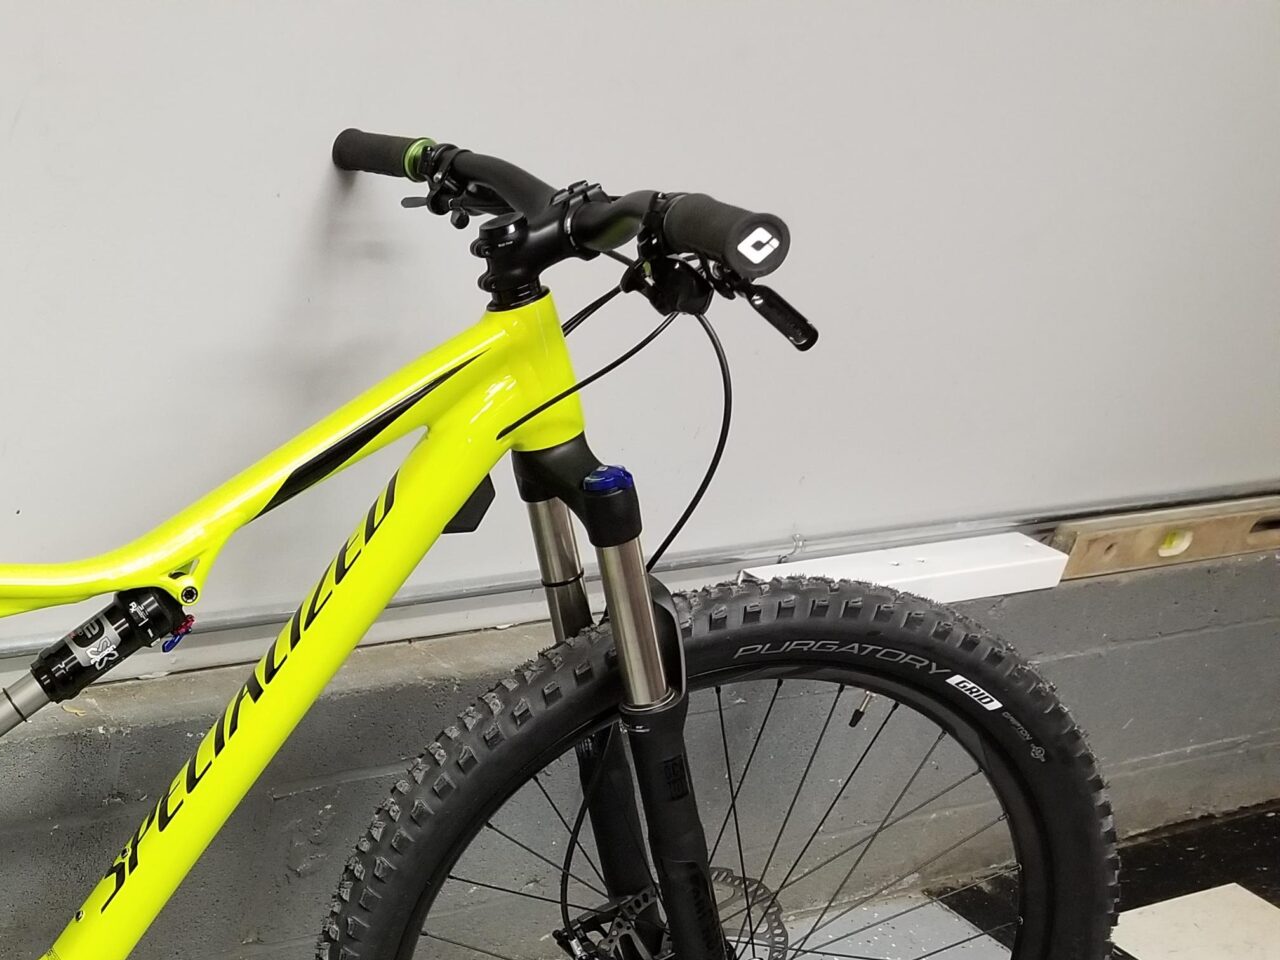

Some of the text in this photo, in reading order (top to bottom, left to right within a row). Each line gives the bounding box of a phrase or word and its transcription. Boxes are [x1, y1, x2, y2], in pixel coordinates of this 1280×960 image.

[101, 469, 399, 914] SPECIALIZED
[733, 640, 995, 705] PURGATORY GRID
